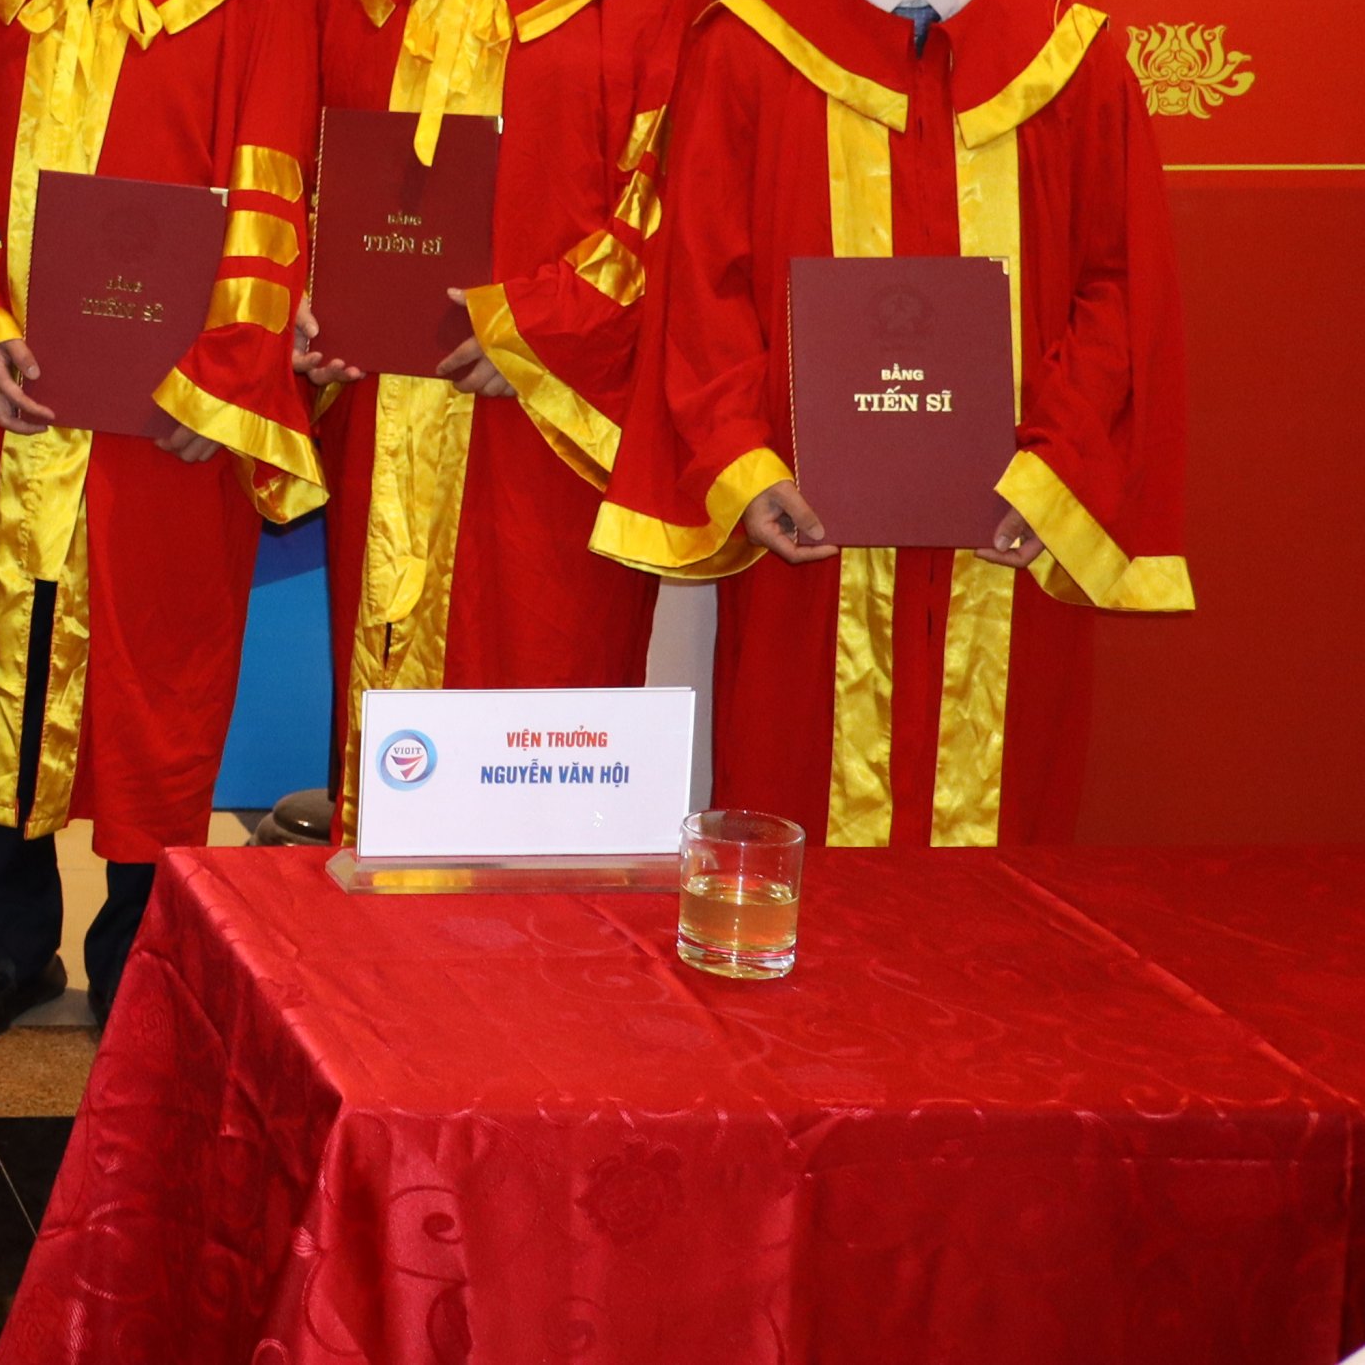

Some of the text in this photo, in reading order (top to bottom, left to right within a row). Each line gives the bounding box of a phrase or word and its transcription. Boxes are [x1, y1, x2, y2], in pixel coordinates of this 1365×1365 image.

[881, 363, 924, 381] BẰNG
[854, 385, 951, 411] TIẾN SĨ
[507, 726, 607, 751] VIỆN TRƯỞNG
[481, 759, 629, 787] NGUYỄN VĂN HỘI
